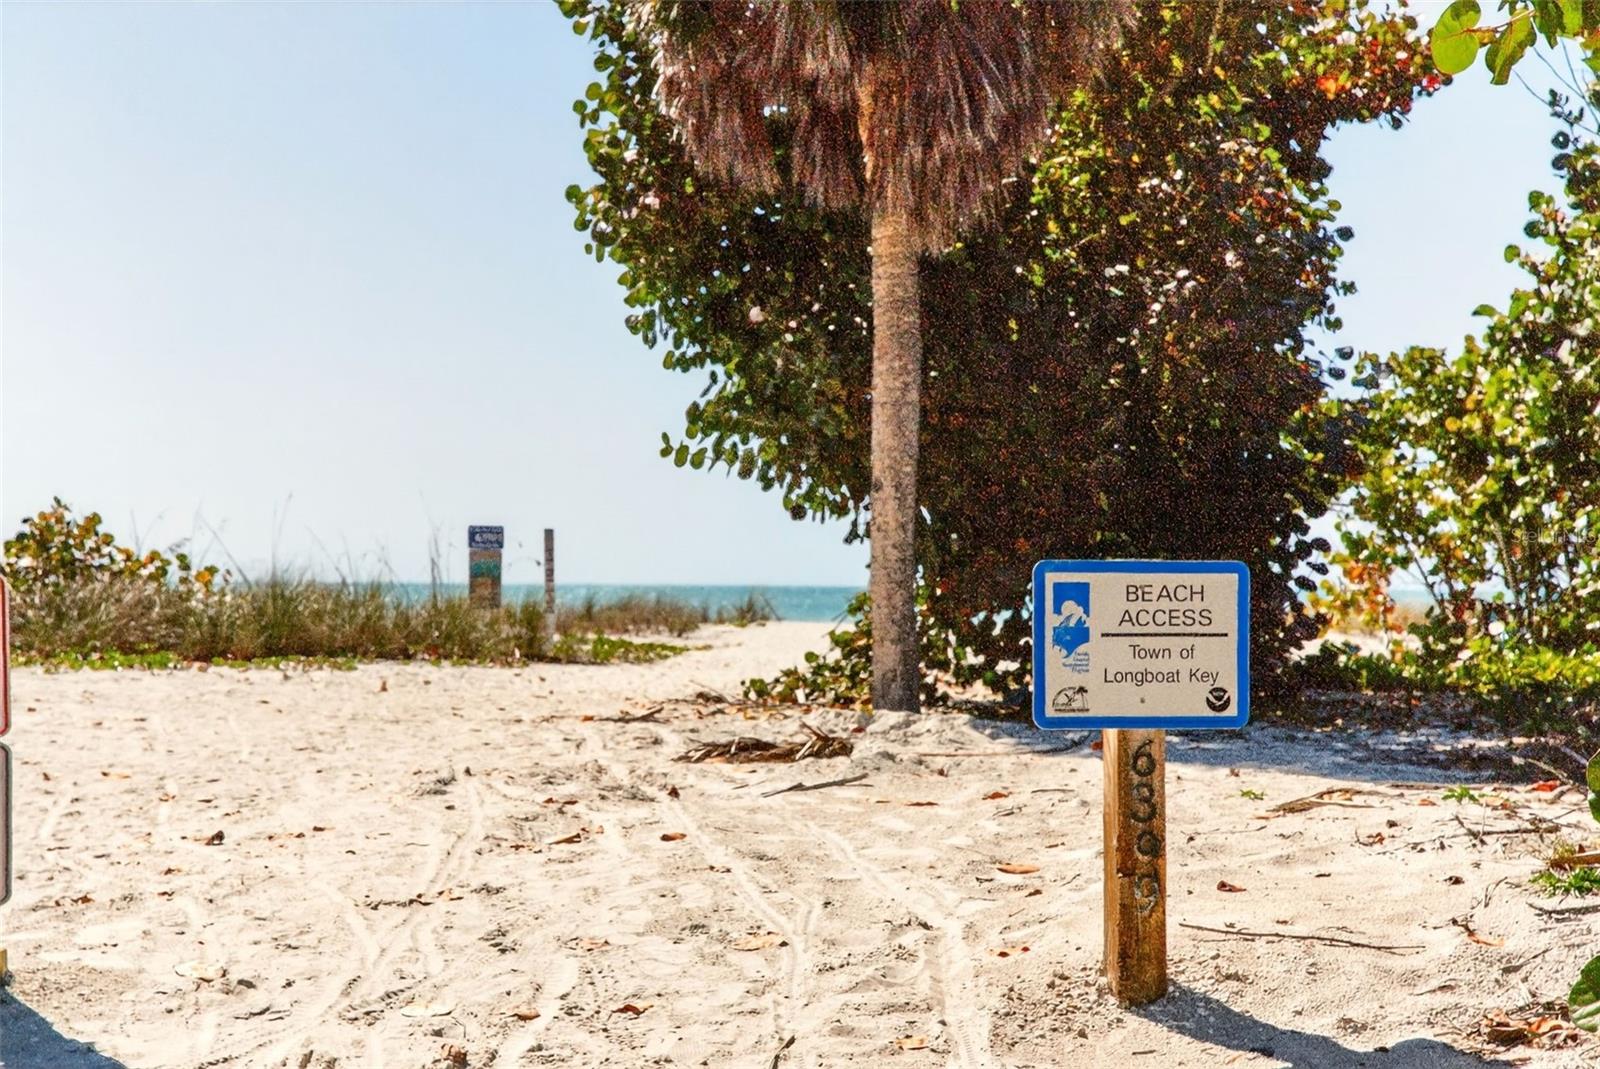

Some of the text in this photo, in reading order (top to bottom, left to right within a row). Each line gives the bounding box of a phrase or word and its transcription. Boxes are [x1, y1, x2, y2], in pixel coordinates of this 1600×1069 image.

[1125, 584, 1205, 602] BEACH
[1118, 608, 1213, 627] ACCESS
[1128, 644, 1195, 660] Town of
[1103, 667, 1220, 687] Longboat Key
